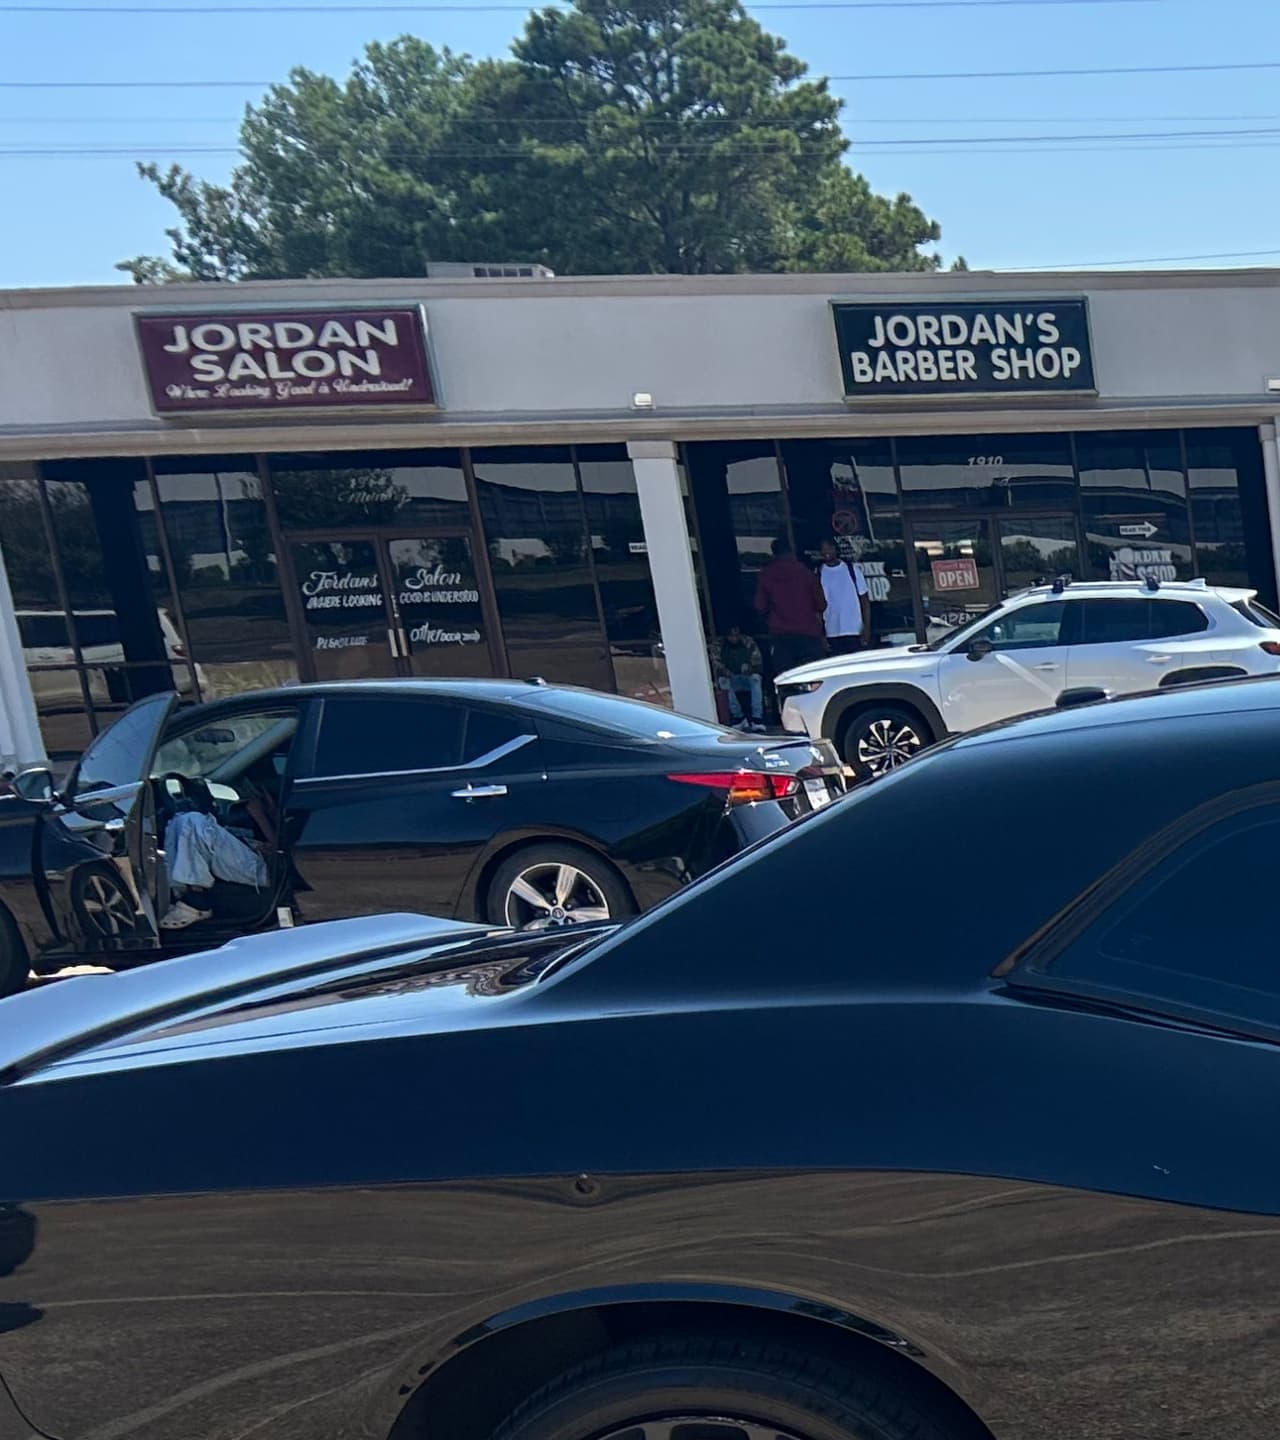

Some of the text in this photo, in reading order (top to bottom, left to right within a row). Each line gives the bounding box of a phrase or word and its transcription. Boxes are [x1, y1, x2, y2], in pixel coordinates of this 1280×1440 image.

[163, 319, 399, 352] JORDAN
[867, 312, 1060, 348] JORDAN'S
[190, 350, 381, 382] SALON
[850, 347, 1081, 382] BARBER SHOP
[405, 564, 461, 590] Salon
[938, 570, 974, 588] OPEN
